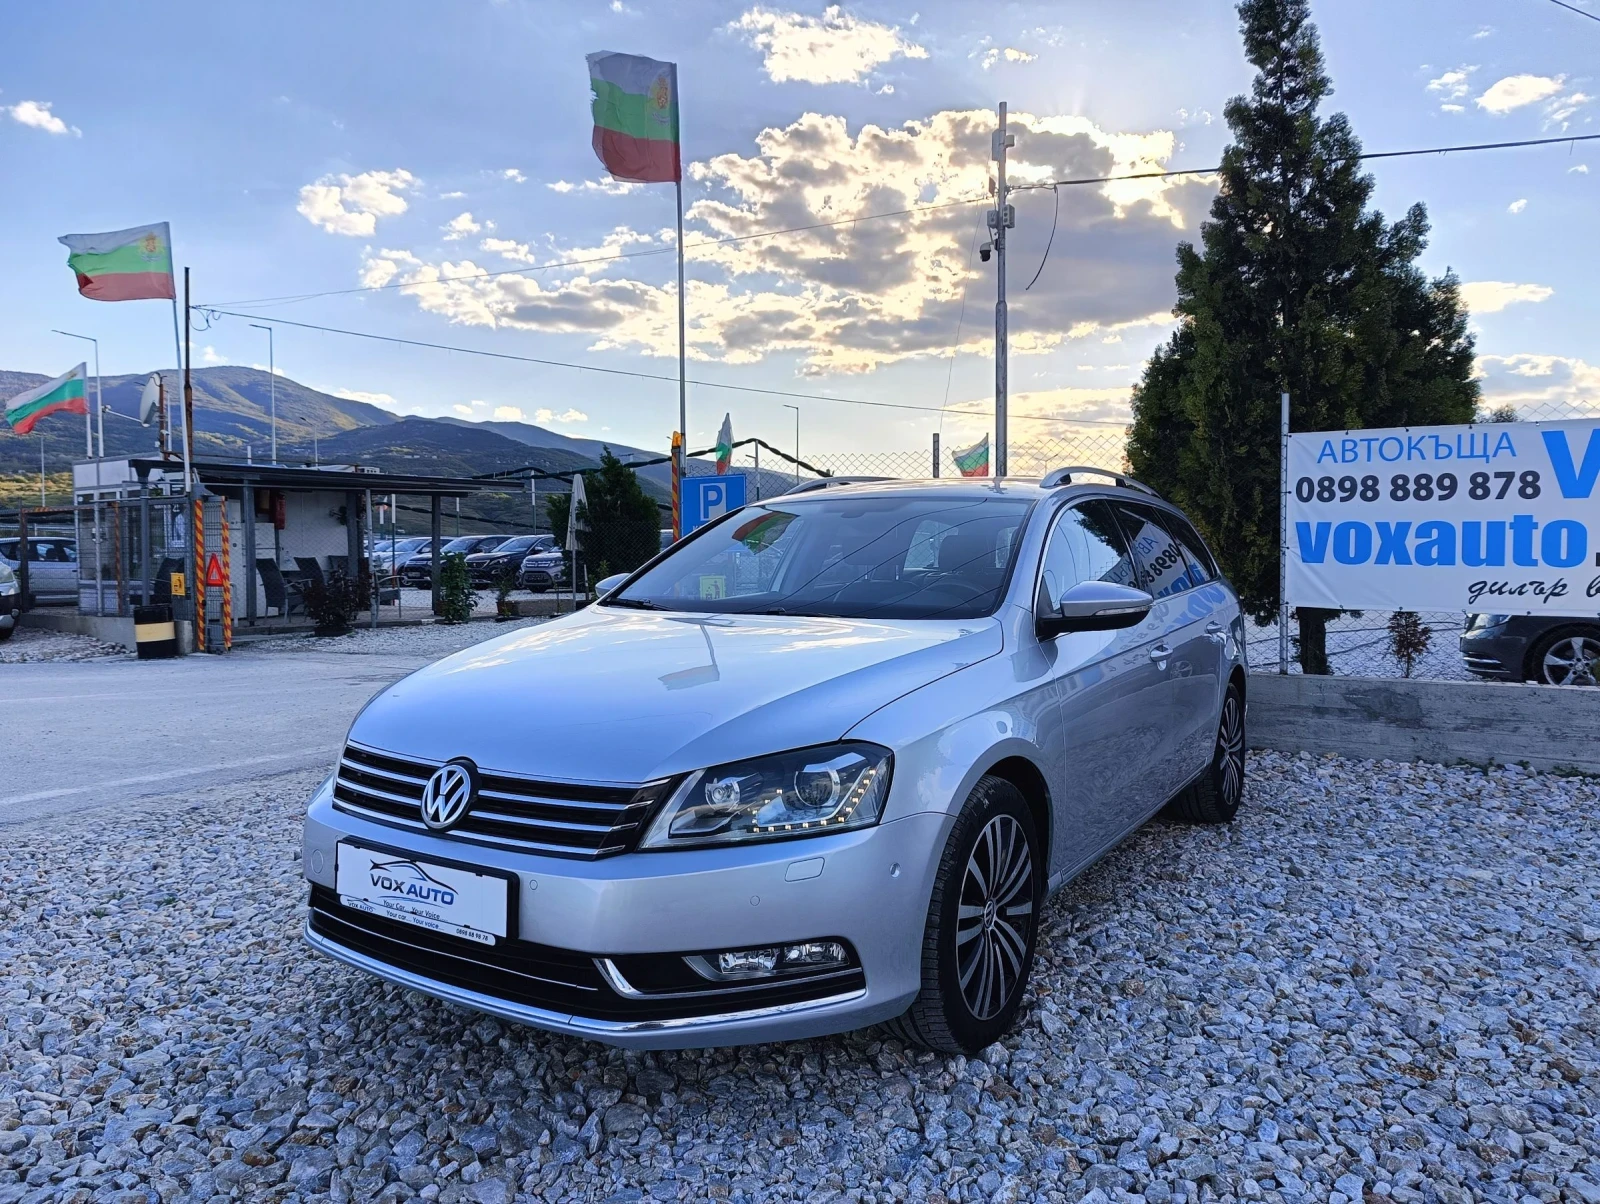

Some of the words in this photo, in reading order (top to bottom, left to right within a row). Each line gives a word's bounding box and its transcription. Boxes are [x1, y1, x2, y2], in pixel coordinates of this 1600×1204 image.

[1316, 431, 1517, 464] АВТОКЪЩА
[703, 485, 723, 519] P
[1295, 473, 1380, 503] 0898
[1389, 472, 1458, 502] 889
[1468, 470, 1541, 500] 878
[1468, 577, 1569, 605] дилър
